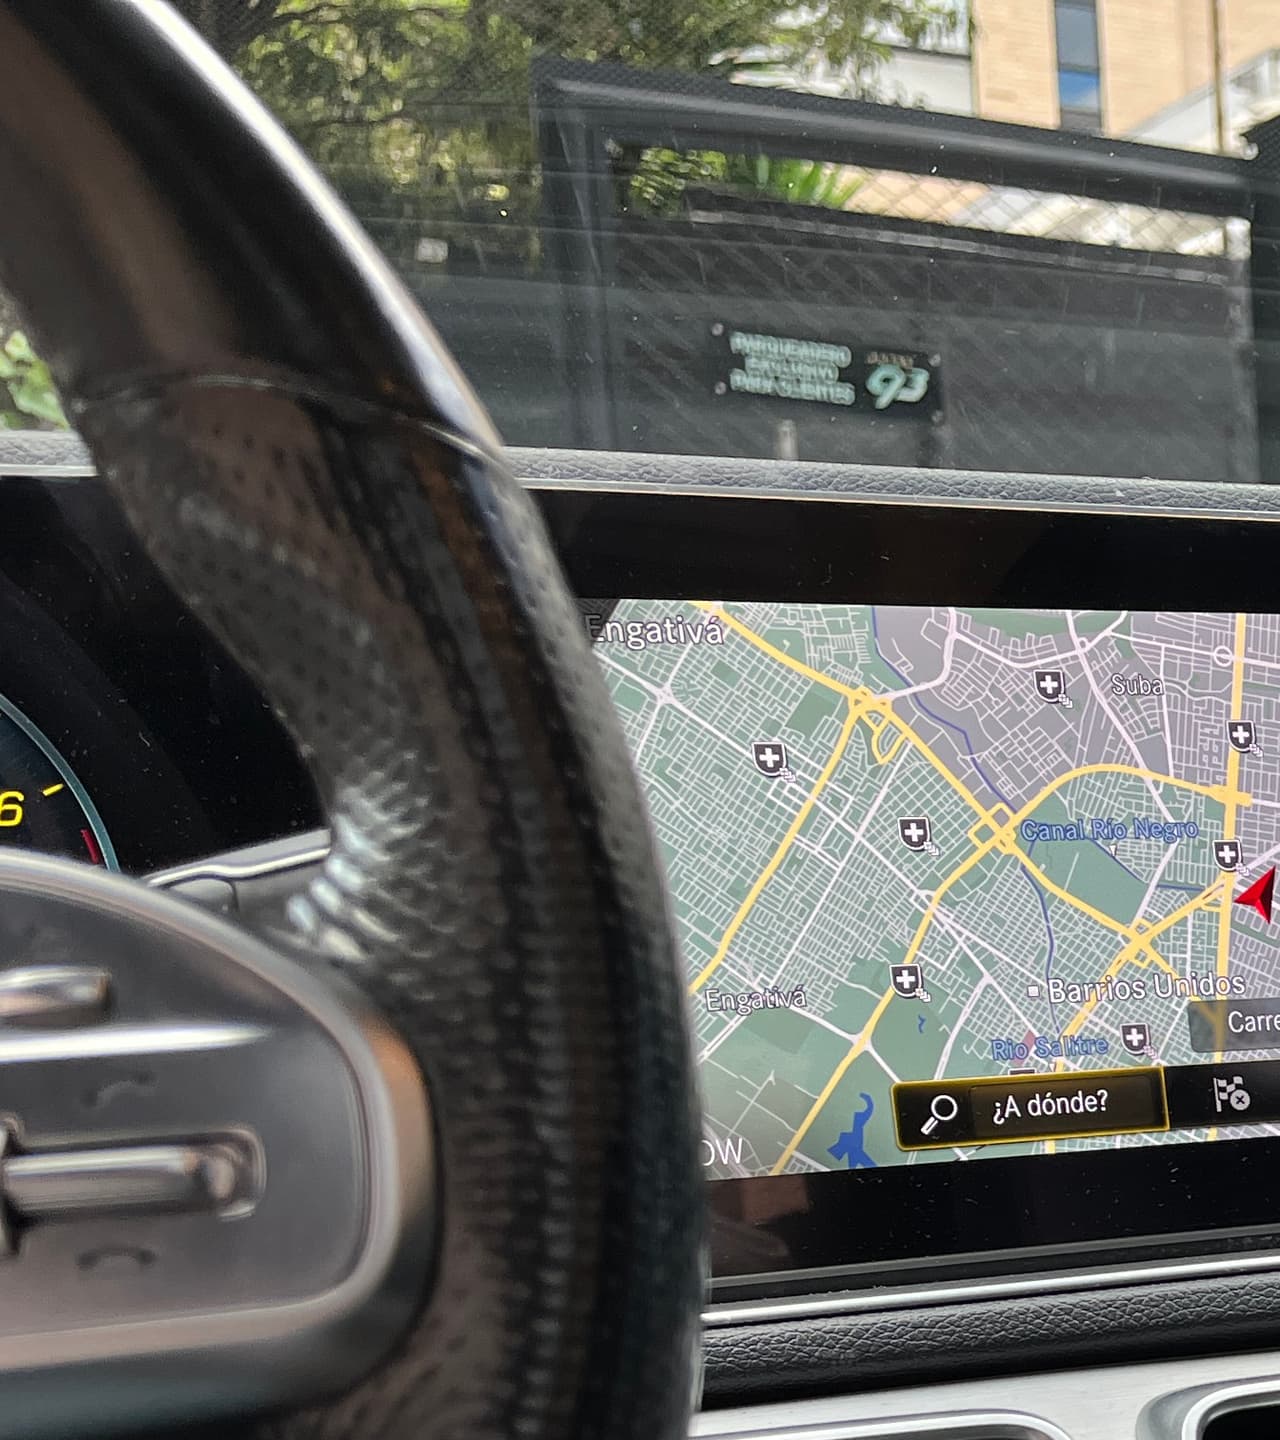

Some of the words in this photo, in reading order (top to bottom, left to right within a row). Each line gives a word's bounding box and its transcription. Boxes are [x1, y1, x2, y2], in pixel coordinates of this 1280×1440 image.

[865, 364, 930, 410] 93
[585, 614, 724, 650] Engativá
[1111, 673, 1164, 696] Suba
[1021, 818, 1086, 842] Canal
[1092, 818, 1128, 839] Río
[1133, 818, 1199, 843] Negro
[705, 984, 807, 1015] Engativá
[1048, 978, 1147, 1004] Barrios
[1153, 972, 1246, 999] Unidos
[1033, 1036, 1109, 1059] Salitre
[992, 1096, 1021, 1126] ¿A
[1027, 1089, 1109, 1117] dónde?
